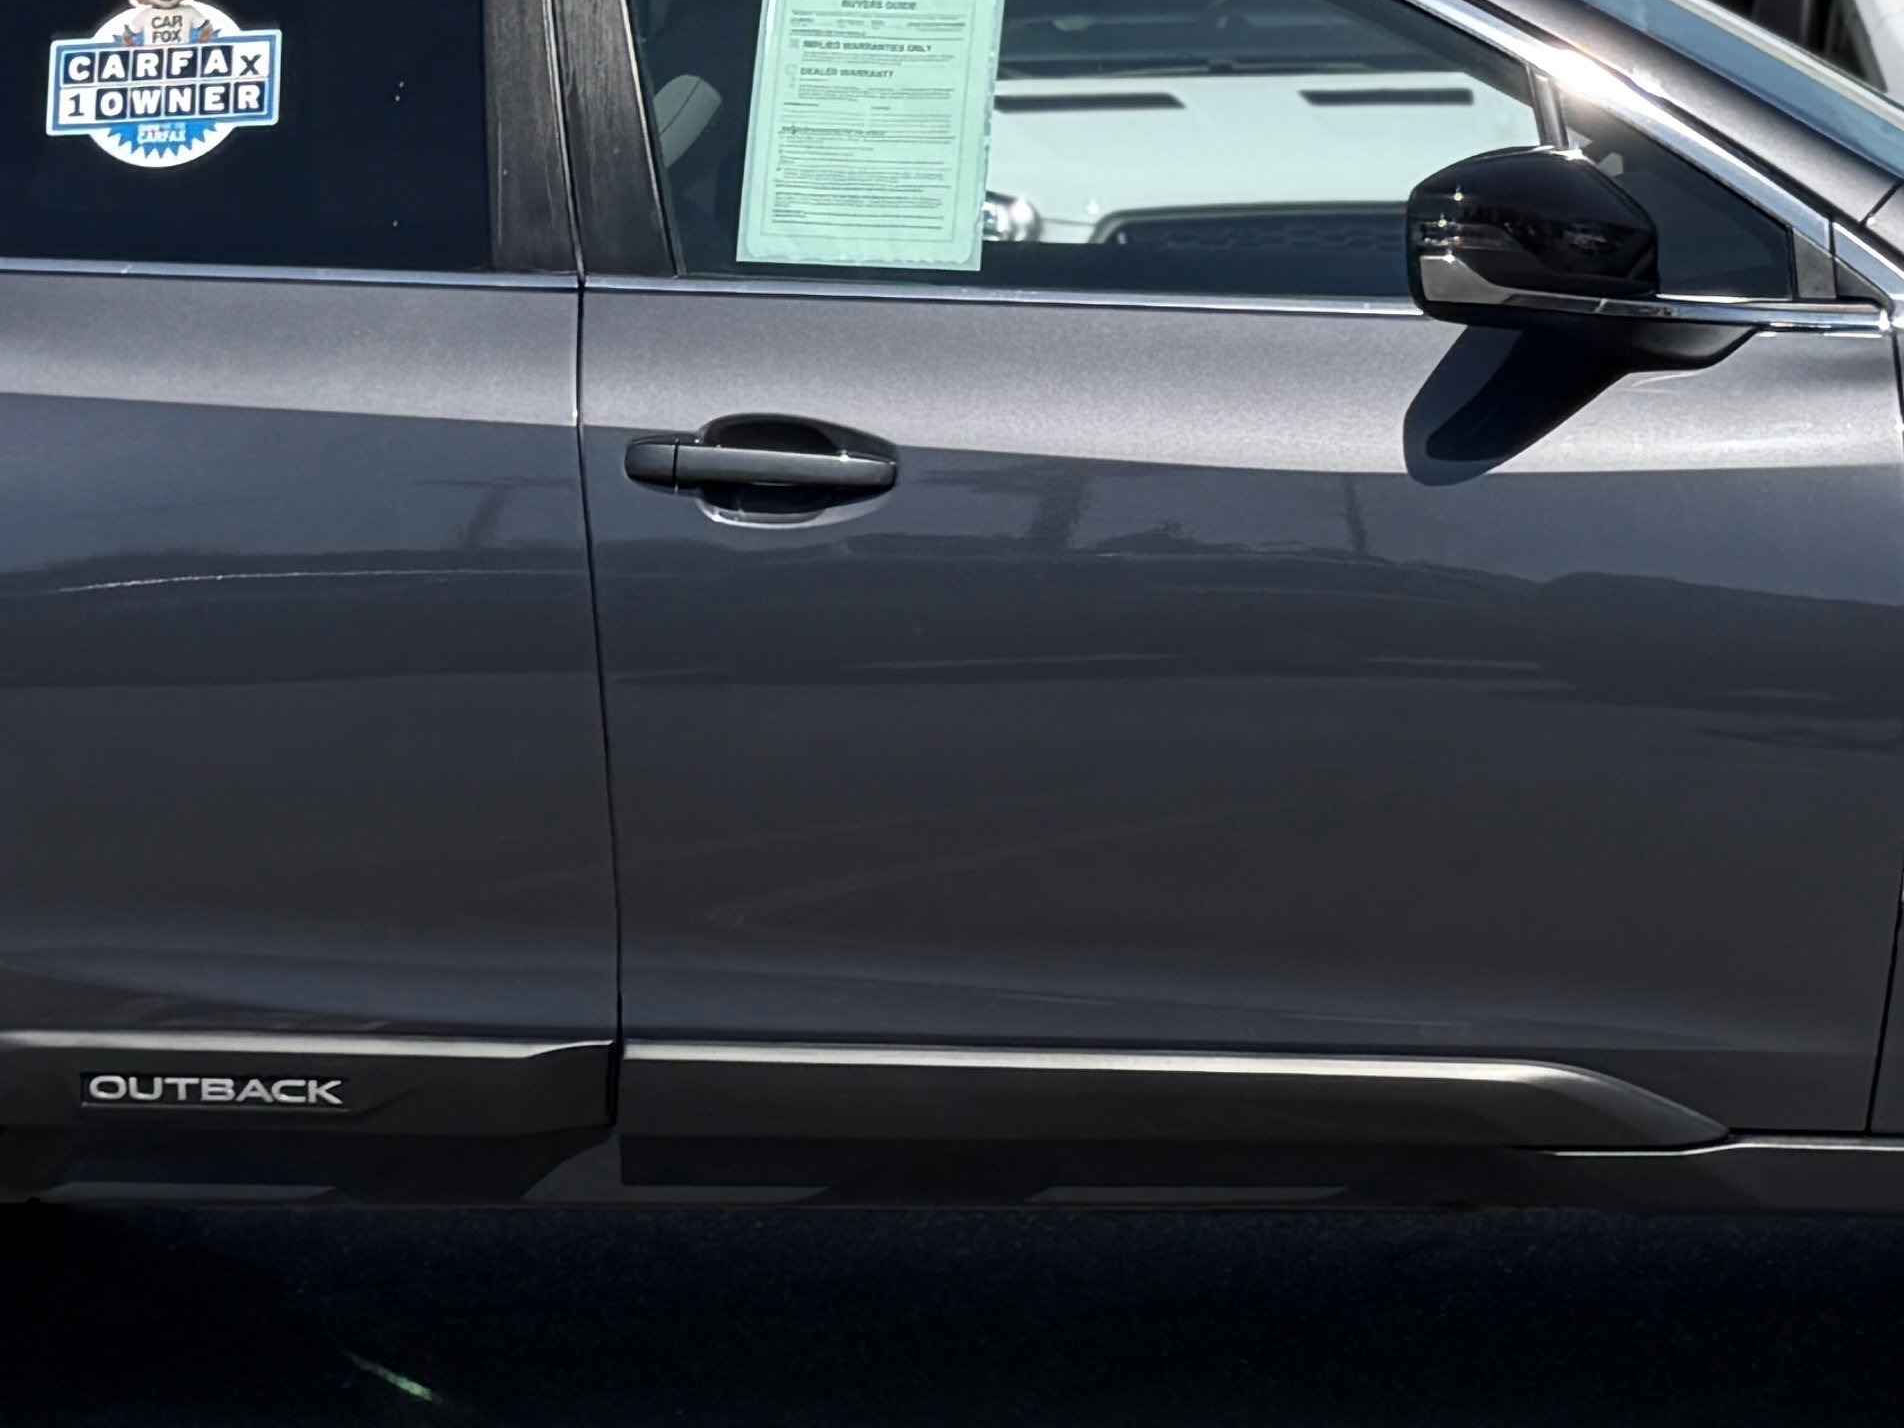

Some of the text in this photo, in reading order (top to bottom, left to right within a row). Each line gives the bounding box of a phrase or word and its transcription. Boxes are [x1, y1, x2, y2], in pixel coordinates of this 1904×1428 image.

[151, 15, 183, 29] CAR
[151, 30, 183, 43] FOX
[68, 47, 263, 82] CARFAX
[67, 84, 261, 117] 1 OWNER
[89, 1075, 344, 1105] OUTBACK
